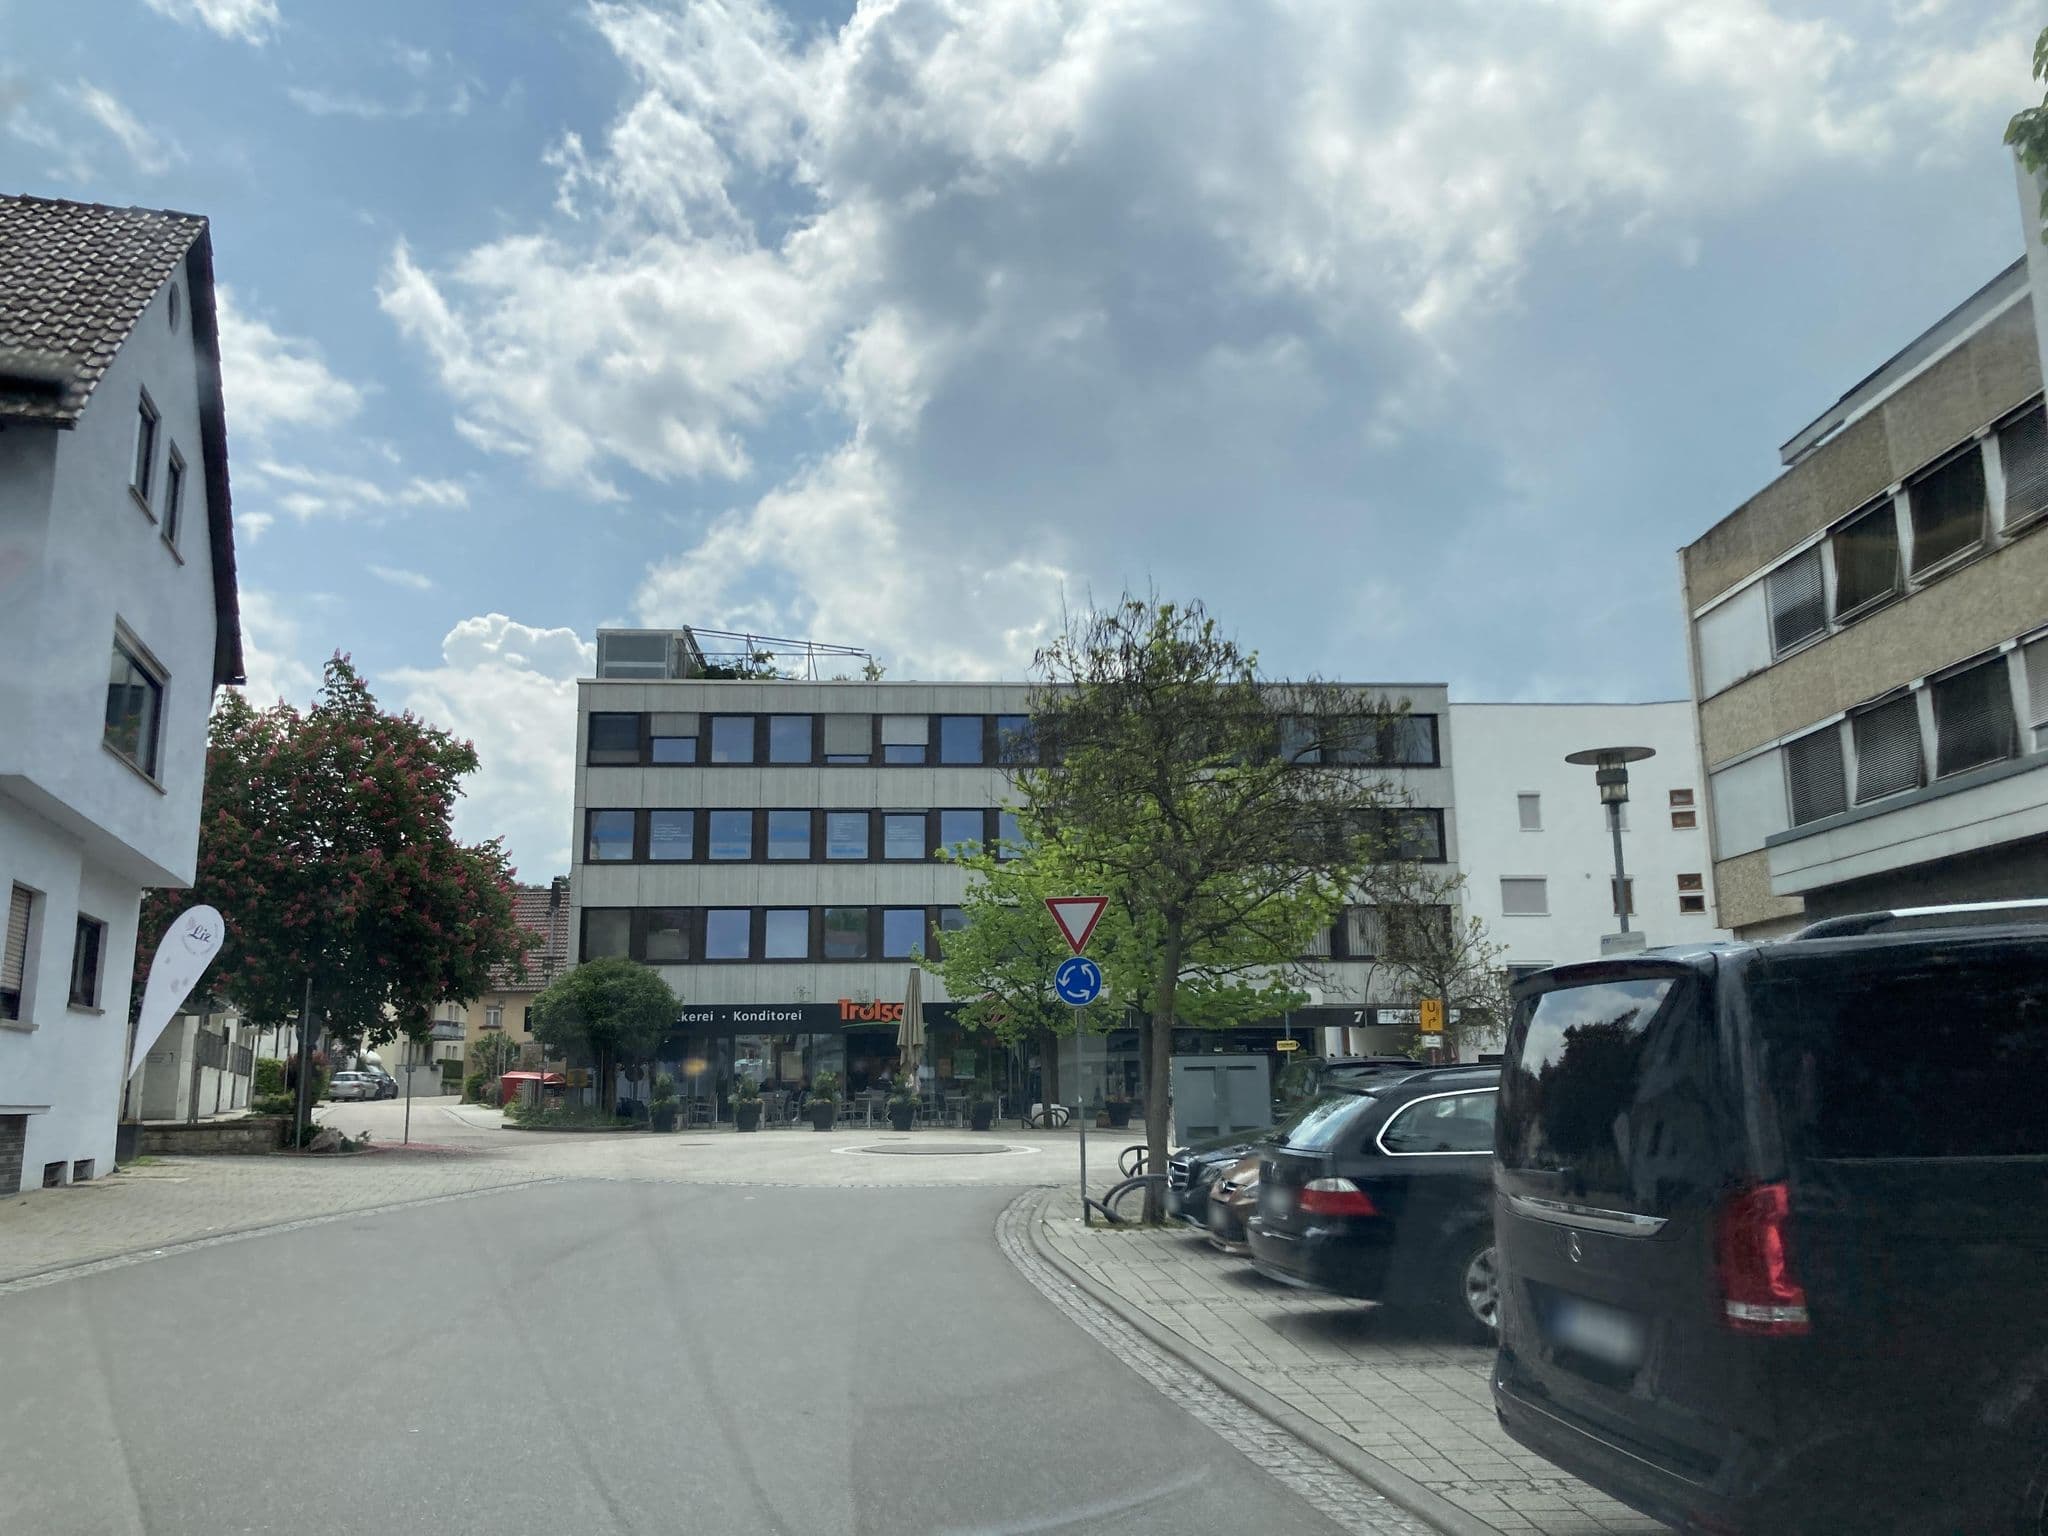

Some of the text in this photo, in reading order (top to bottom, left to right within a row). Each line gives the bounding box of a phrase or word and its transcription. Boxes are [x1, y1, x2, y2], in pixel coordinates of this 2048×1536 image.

[187, 926, 212, 943] Liz
[1427, 1002, 1436, 1012] U
[677, 1009, 802, 1022] kerei Konditorei
[1354, 1011, 1364, 1023] 7
